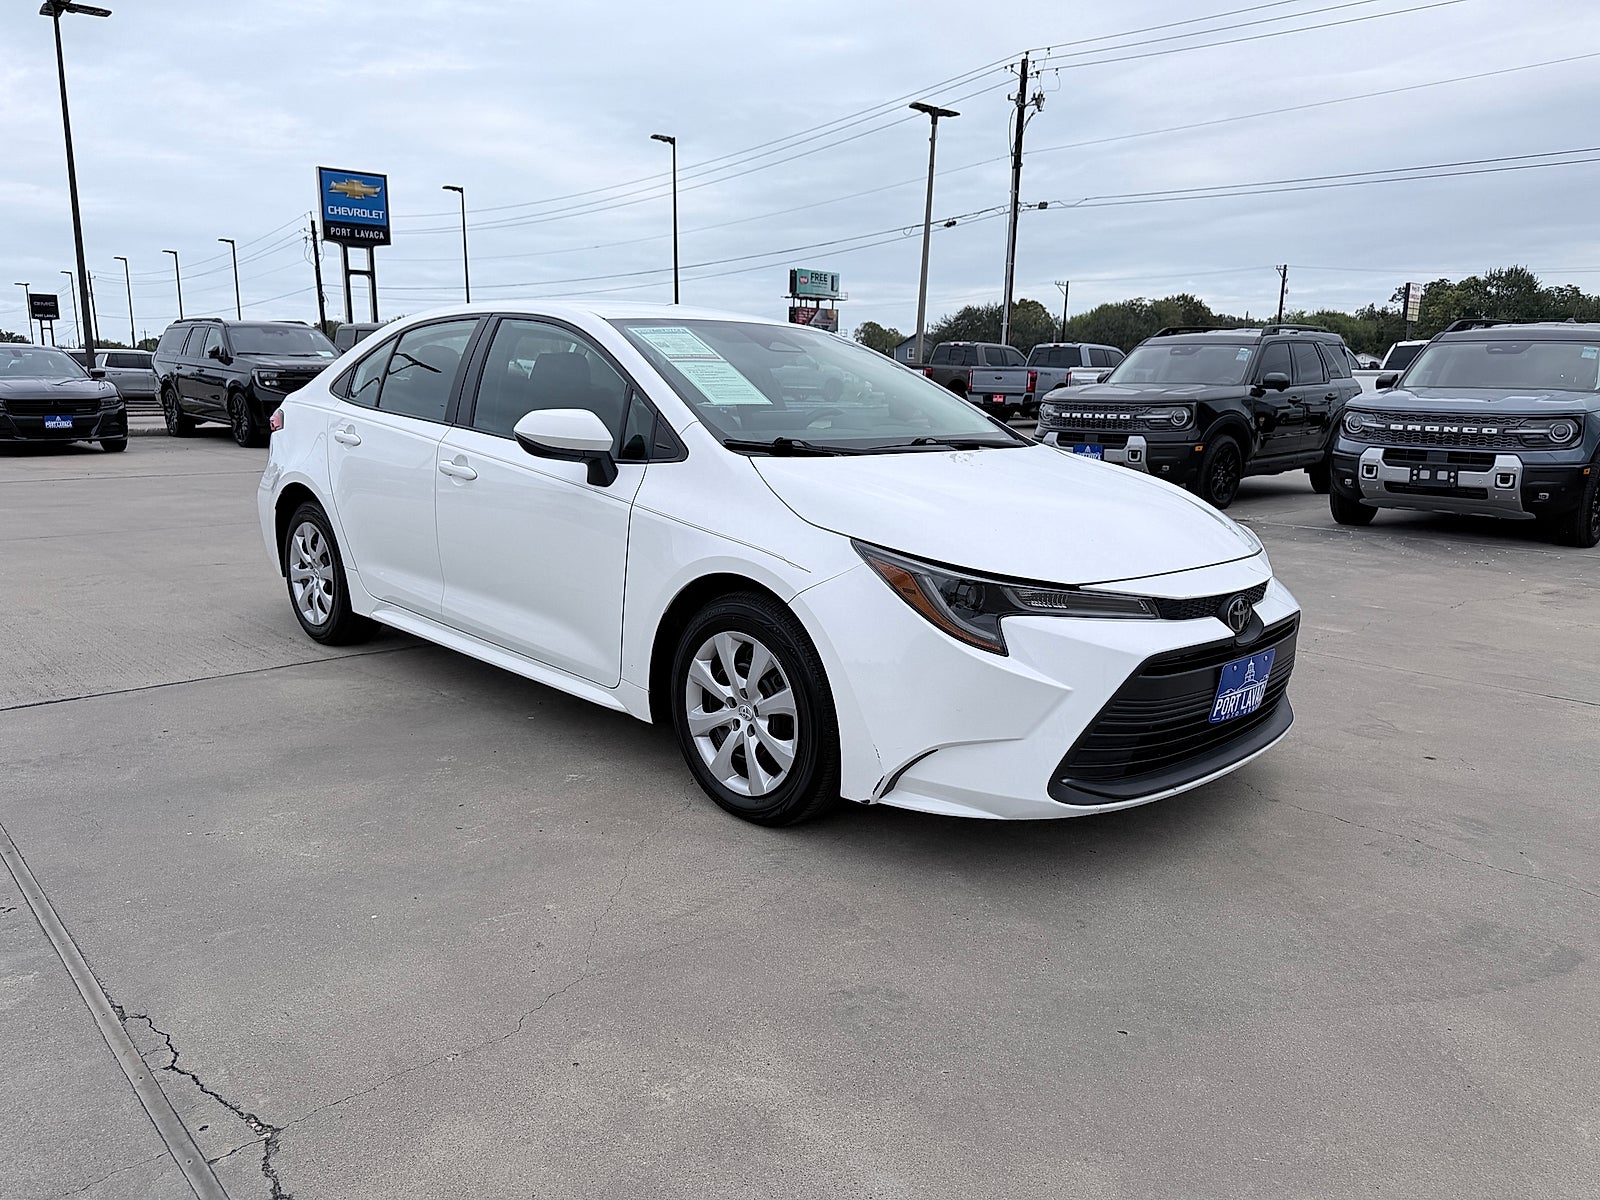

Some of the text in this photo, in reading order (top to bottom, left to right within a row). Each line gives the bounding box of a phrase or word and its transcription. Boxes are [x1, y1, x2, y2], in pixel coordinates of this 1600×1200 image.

[327, 205, 384, 219] CHEVROLET
[330, 227, 385, 240] PORT LAVACA
[811, 272, 828, 282] FREE
[1061, 412, 1131, 420] BRONCO
[1389, 423, 1498, 434] BRONCO
[1212, 693, 1242, 717] PORT
